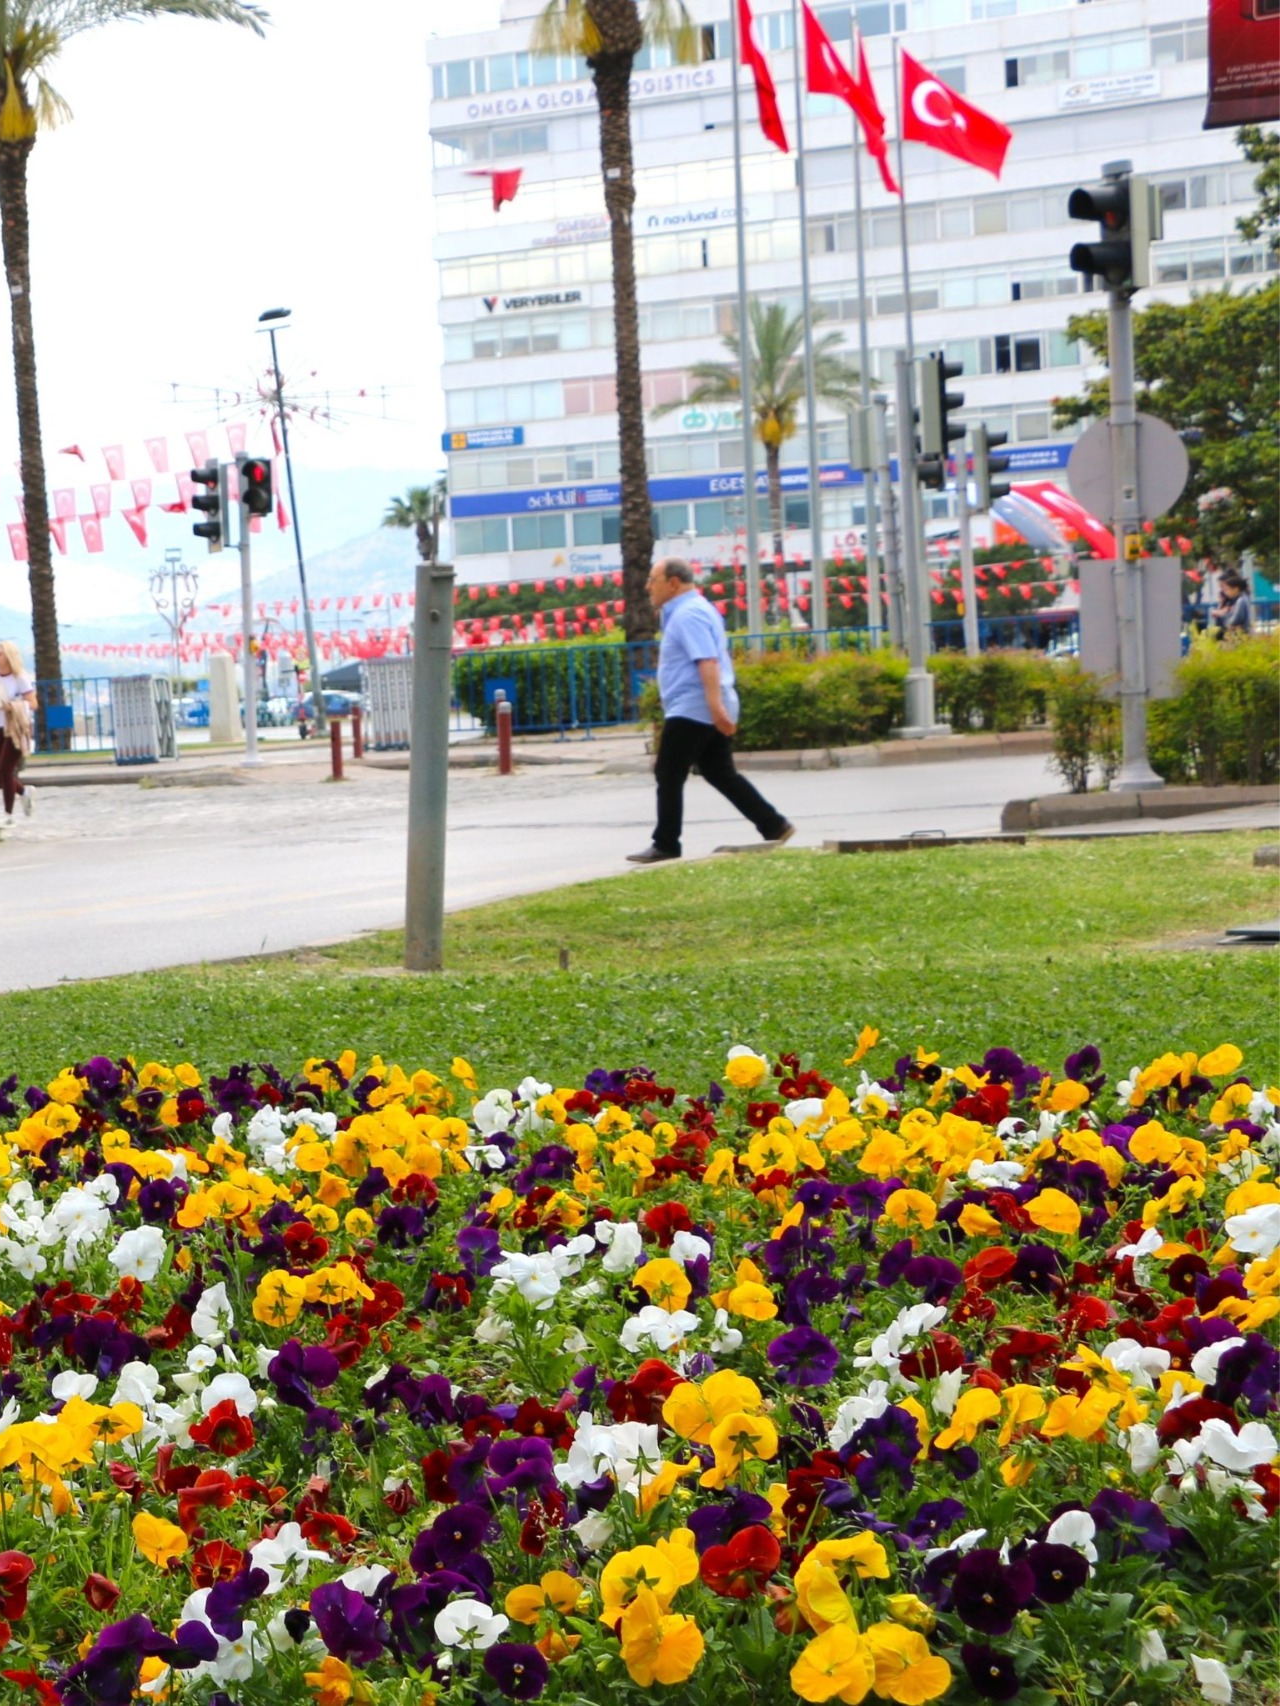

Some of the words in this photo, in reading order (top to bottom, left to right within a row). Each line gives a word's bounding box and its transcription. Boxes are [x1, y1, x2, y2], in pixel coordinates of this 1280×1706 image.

[467, 98, 531, 119] OMEGA
[537, 89, 597, 110] GLOBA
[631, 68, 716, 97] OGISTICS
